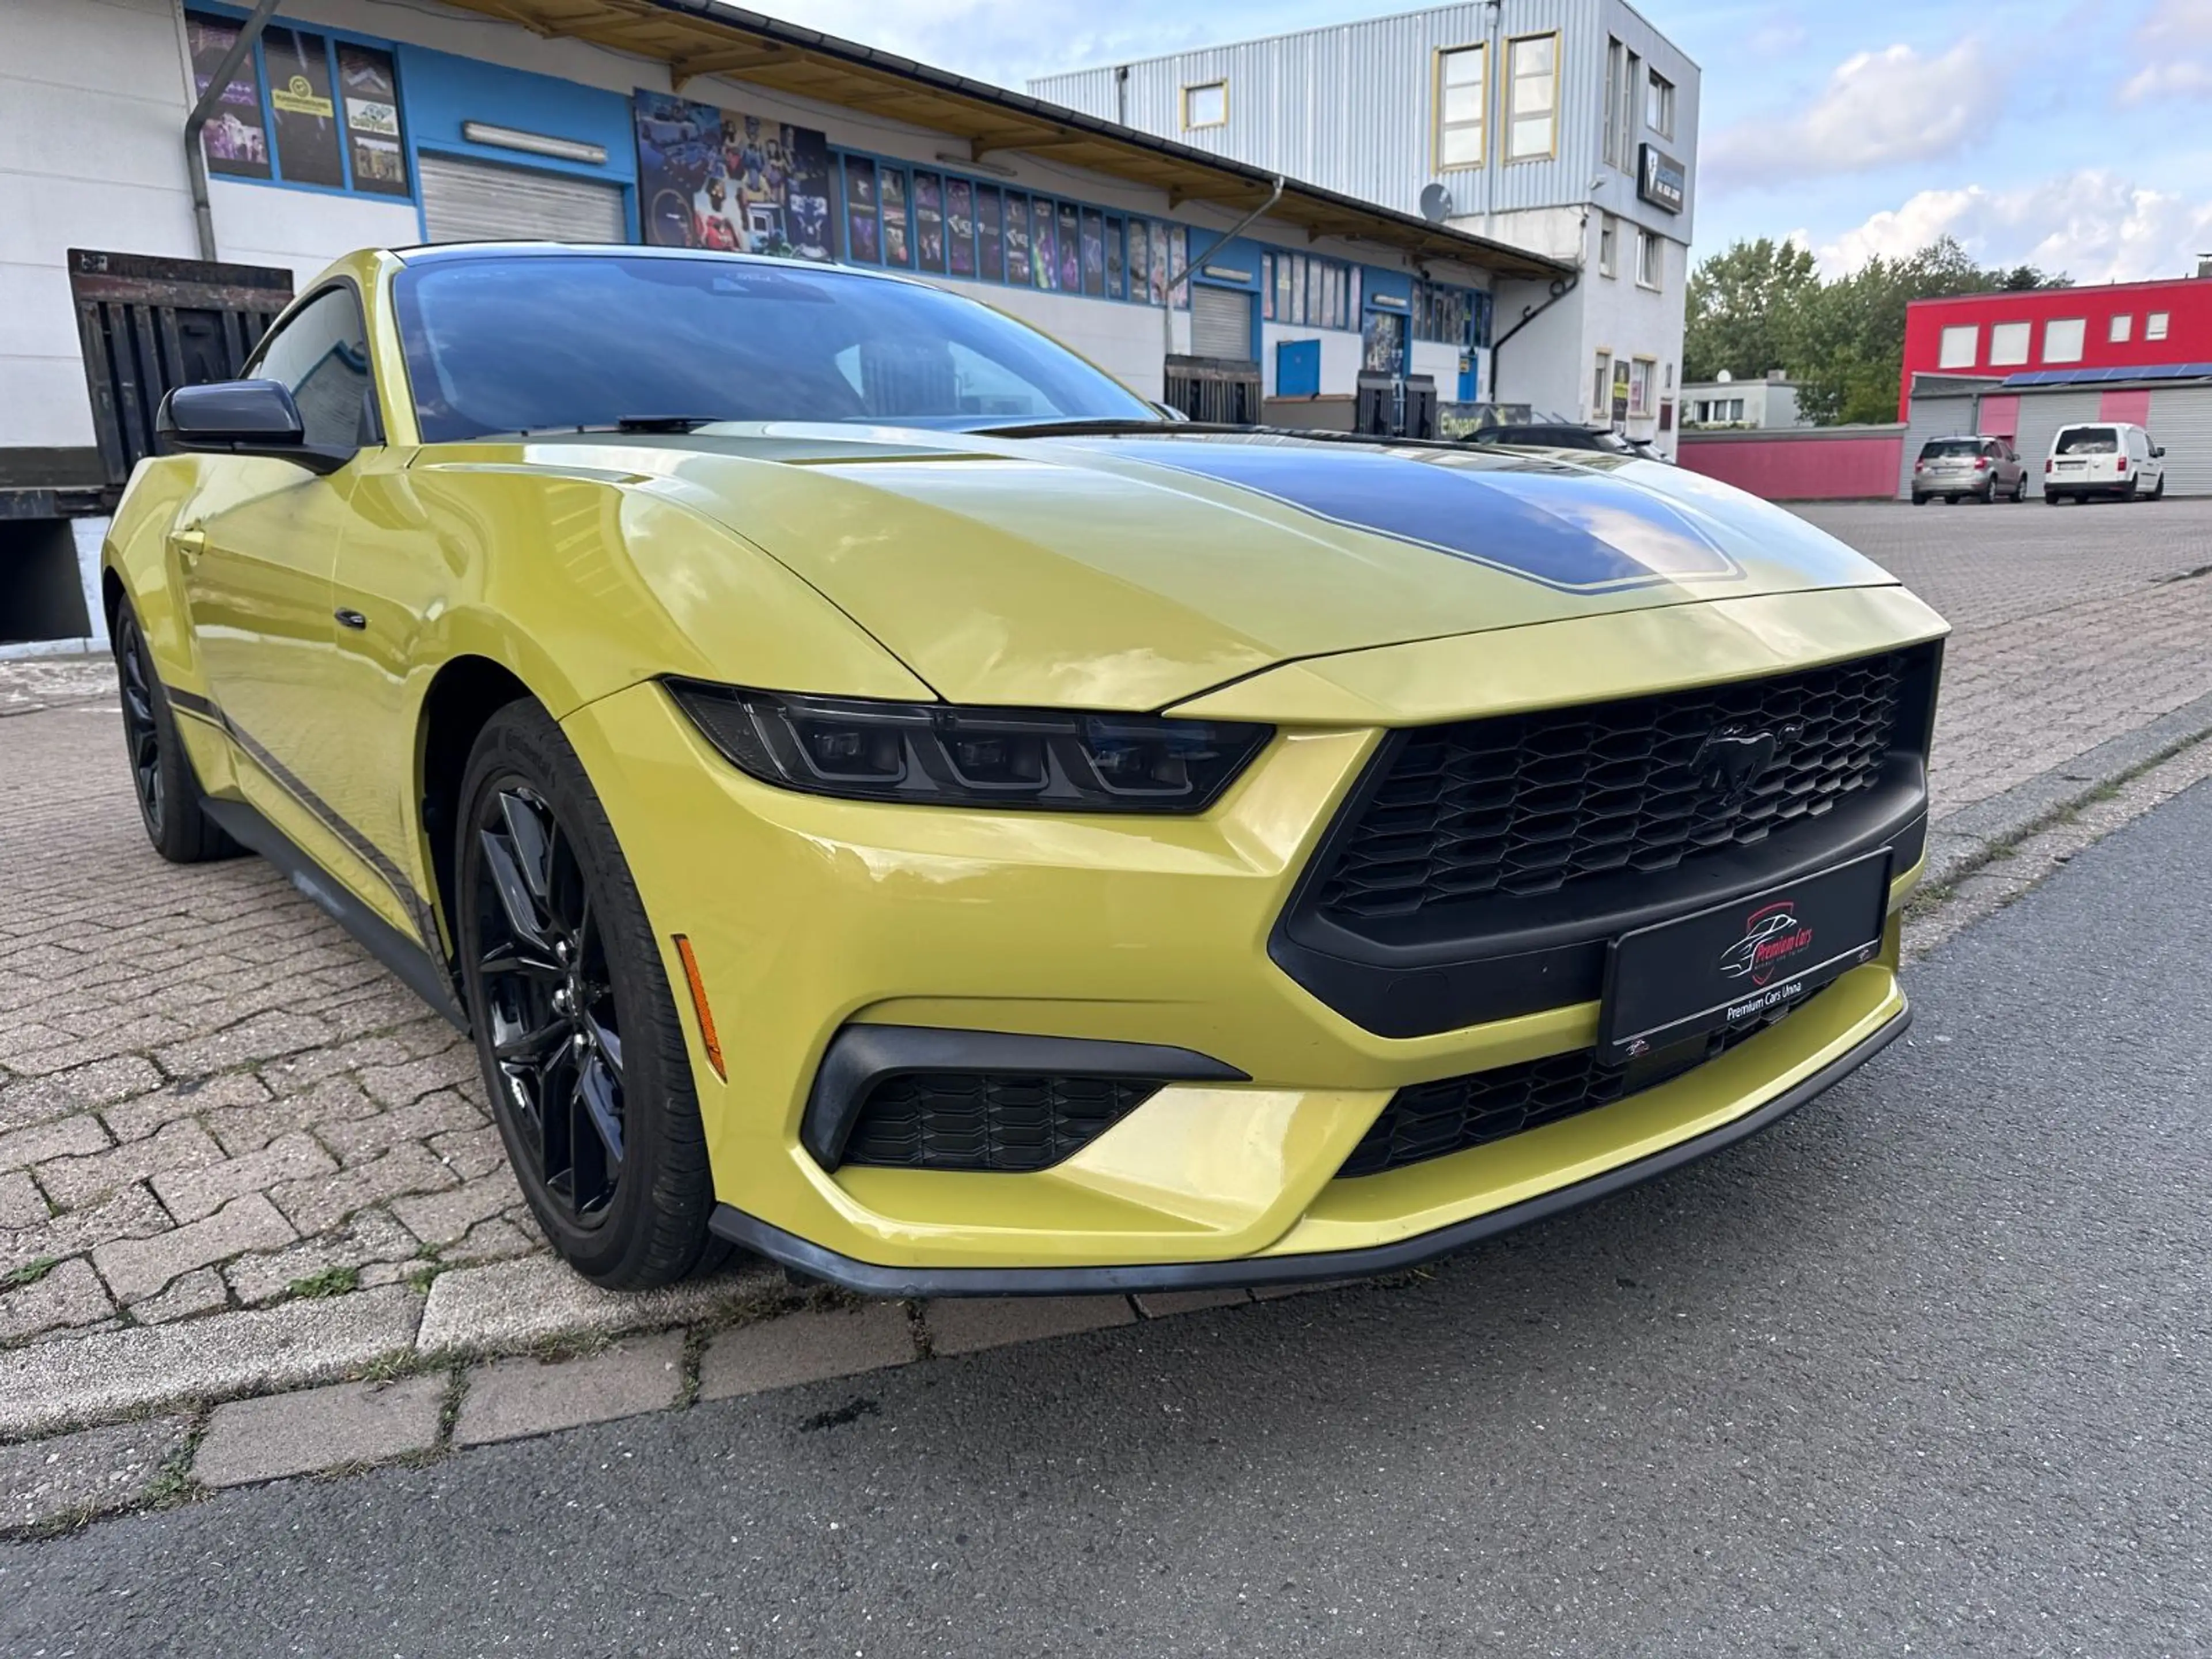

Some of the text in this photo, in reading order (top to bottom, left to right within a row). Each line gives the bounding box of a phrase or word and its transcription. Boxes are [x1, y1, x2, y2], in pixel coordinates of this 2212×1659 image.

[1756, 935, 1795, 963] Premium
[1795, 927, 1812, 948] Cars
[1726, 982, 1801, 1021] Premium Cars Unna
